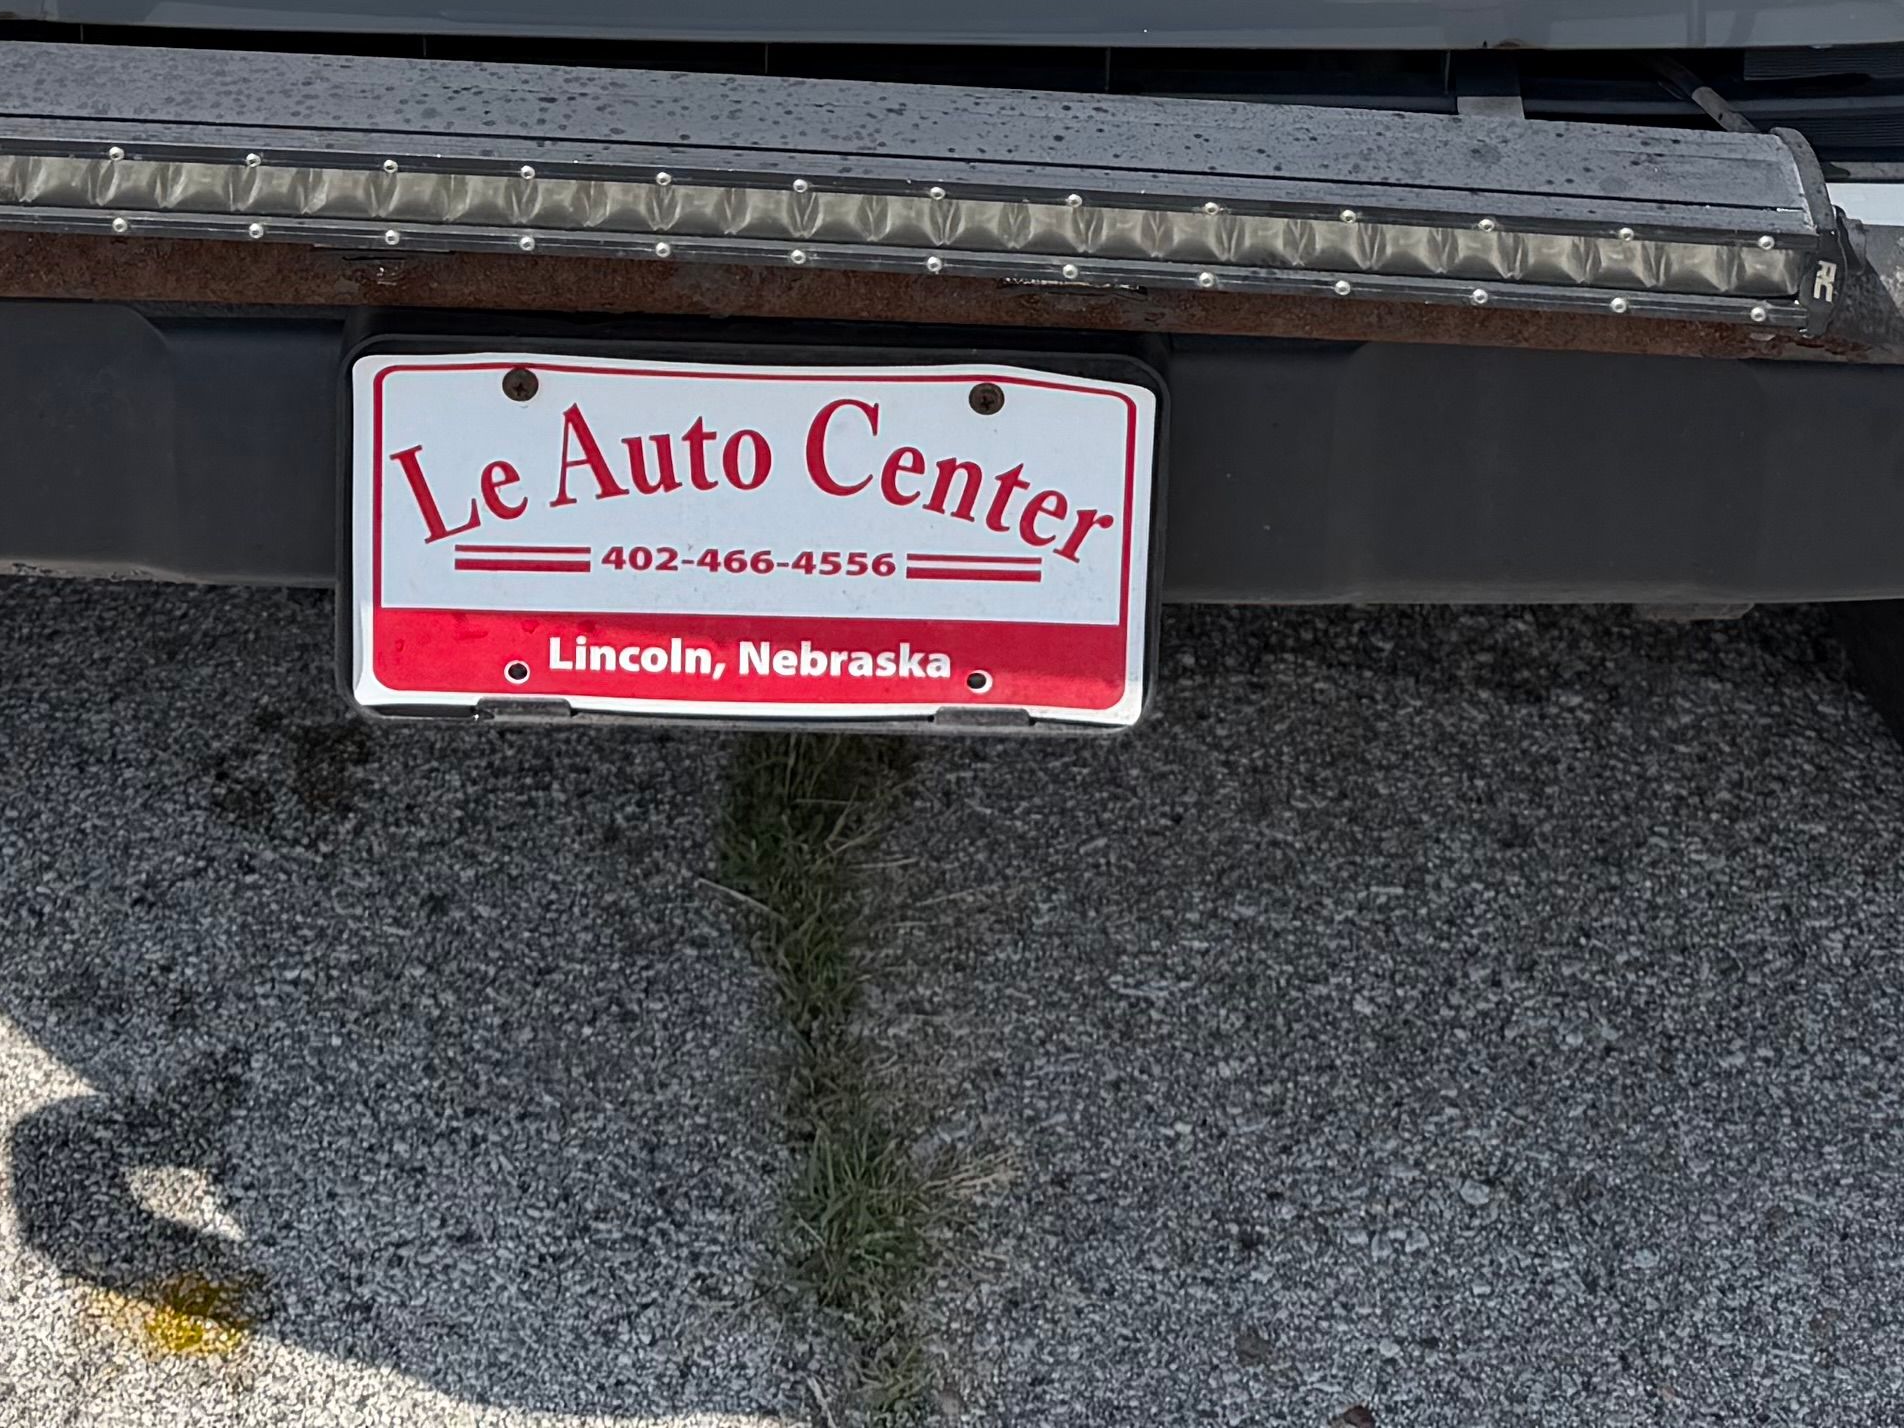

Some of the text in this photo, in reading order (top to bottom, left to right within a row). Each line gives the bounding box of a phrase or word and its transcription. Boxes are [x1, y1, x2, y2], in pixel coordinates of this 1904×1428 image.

[1814, 259, 1837, 302] RC
[390, 398, 1114, 563] Le Auto Center
[601, 546, 897, 577] 402-466-4556
[549, 635, 951, 680] Lincoln, Nebraska
